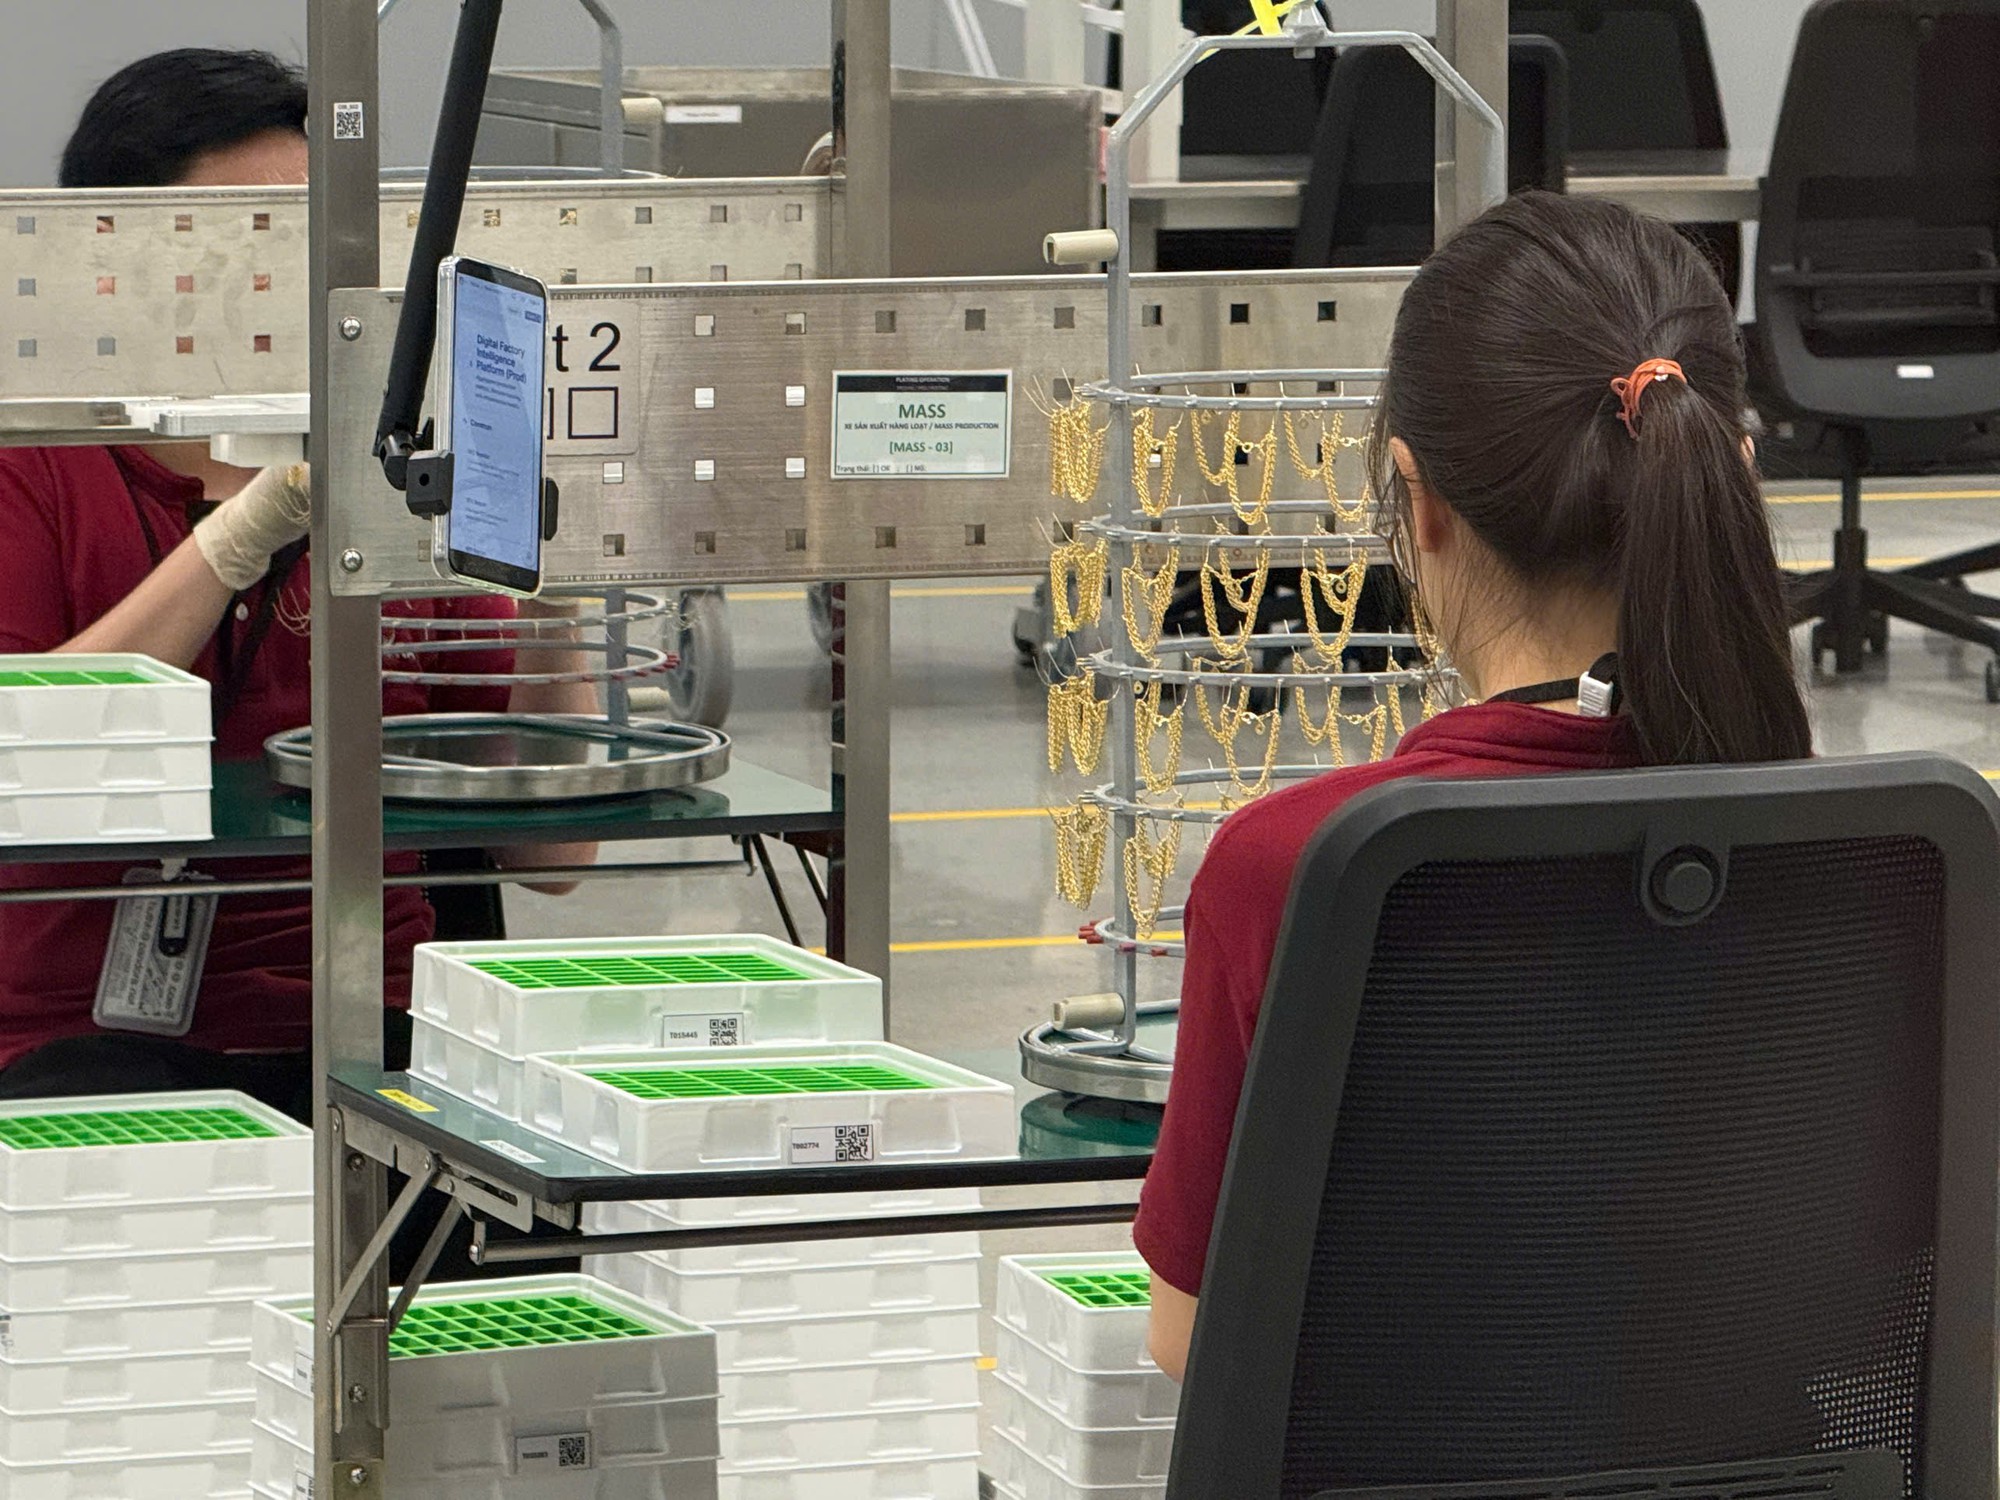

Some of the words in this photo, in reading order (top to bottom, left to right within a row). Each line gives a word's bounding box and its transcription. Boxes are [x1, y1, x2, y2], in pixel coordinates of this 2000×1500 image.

[477, 334, 498, 349] Digital
[500, 341, 525, 359] Factory
[551, 323, 569, 372] t
[589, 322, 620, 371] 2
[477, 347, 515, 367] Intelligence
[476, 360, 504, 376] Platform
[506, 369, 527, 384] (Prod)
[899, 404, 946, 418] MASS
[869, 421, 887, 430] XUẤT
[889, 421, 909, 430] HÀNG
[889, 441, 926, 455] [MASS
[935, 441, 953, 455] 03]
